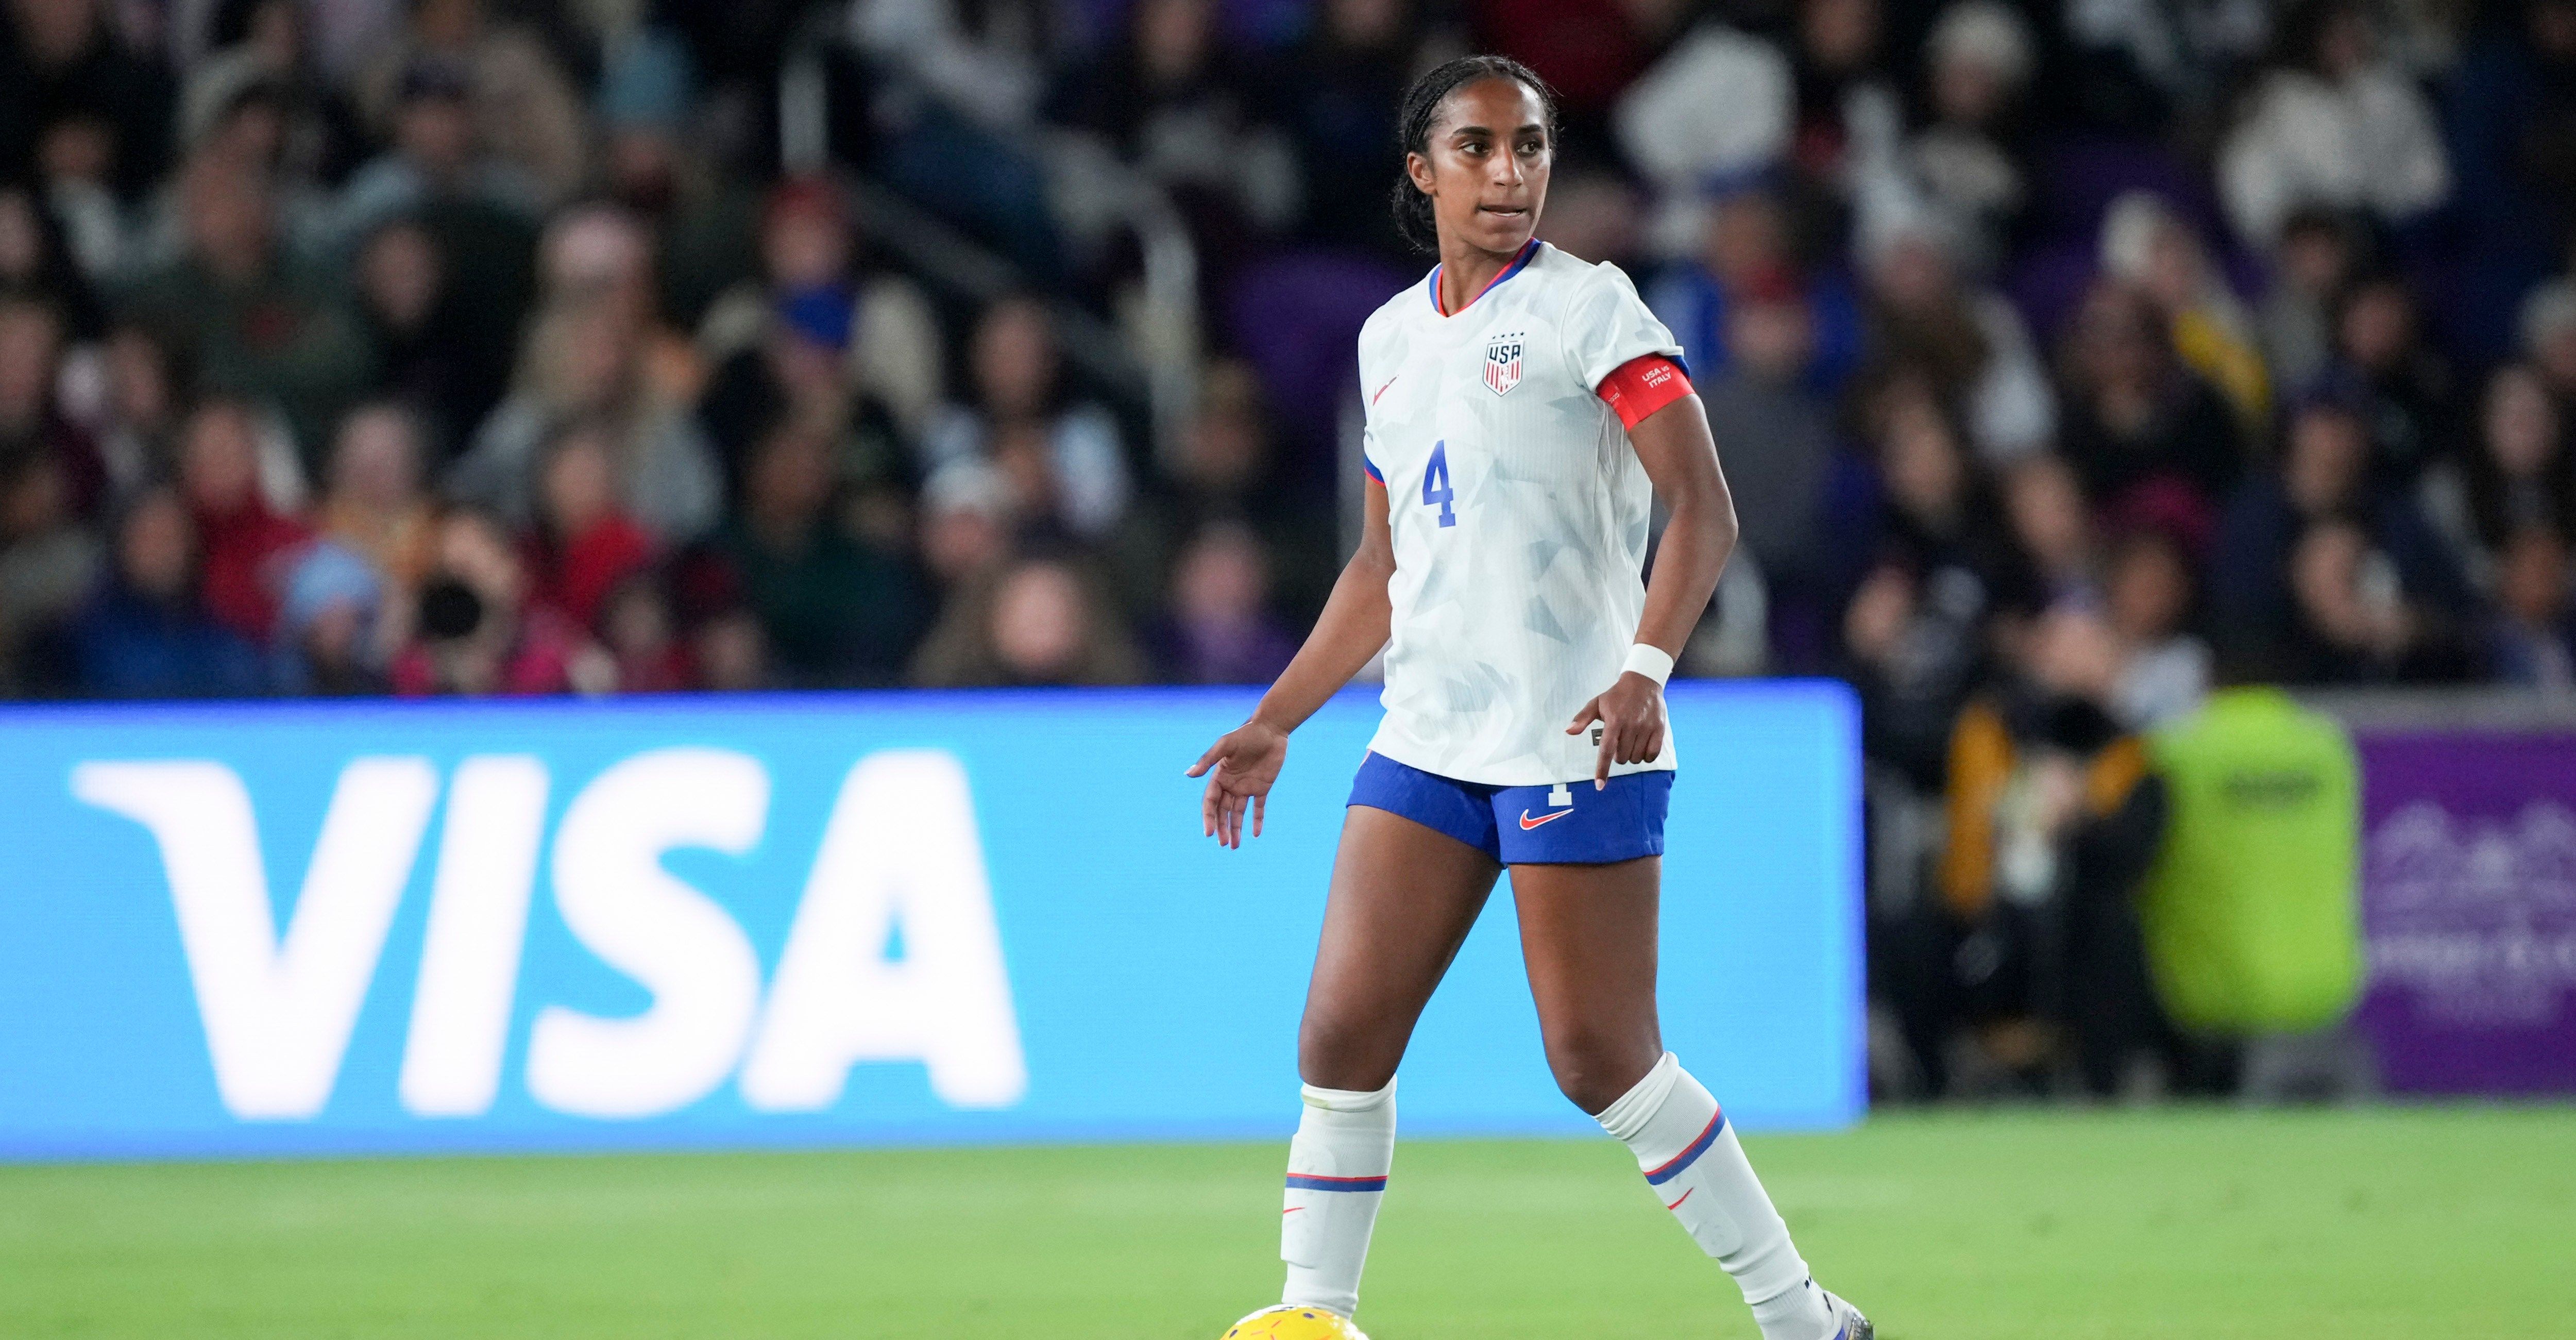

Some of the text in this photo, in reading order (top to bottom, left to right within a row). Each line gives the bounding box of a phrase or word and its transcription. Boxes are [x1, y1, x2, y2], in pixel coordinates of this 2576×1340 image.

[1489, 345, 1520, 364] USA
[1642, 368, 1662, 381] USA
[1649, 372, 1671, 388] ITALY
[1422, 440, 1455, 528] 4
[71, 747, 1027, 1119] VISA
